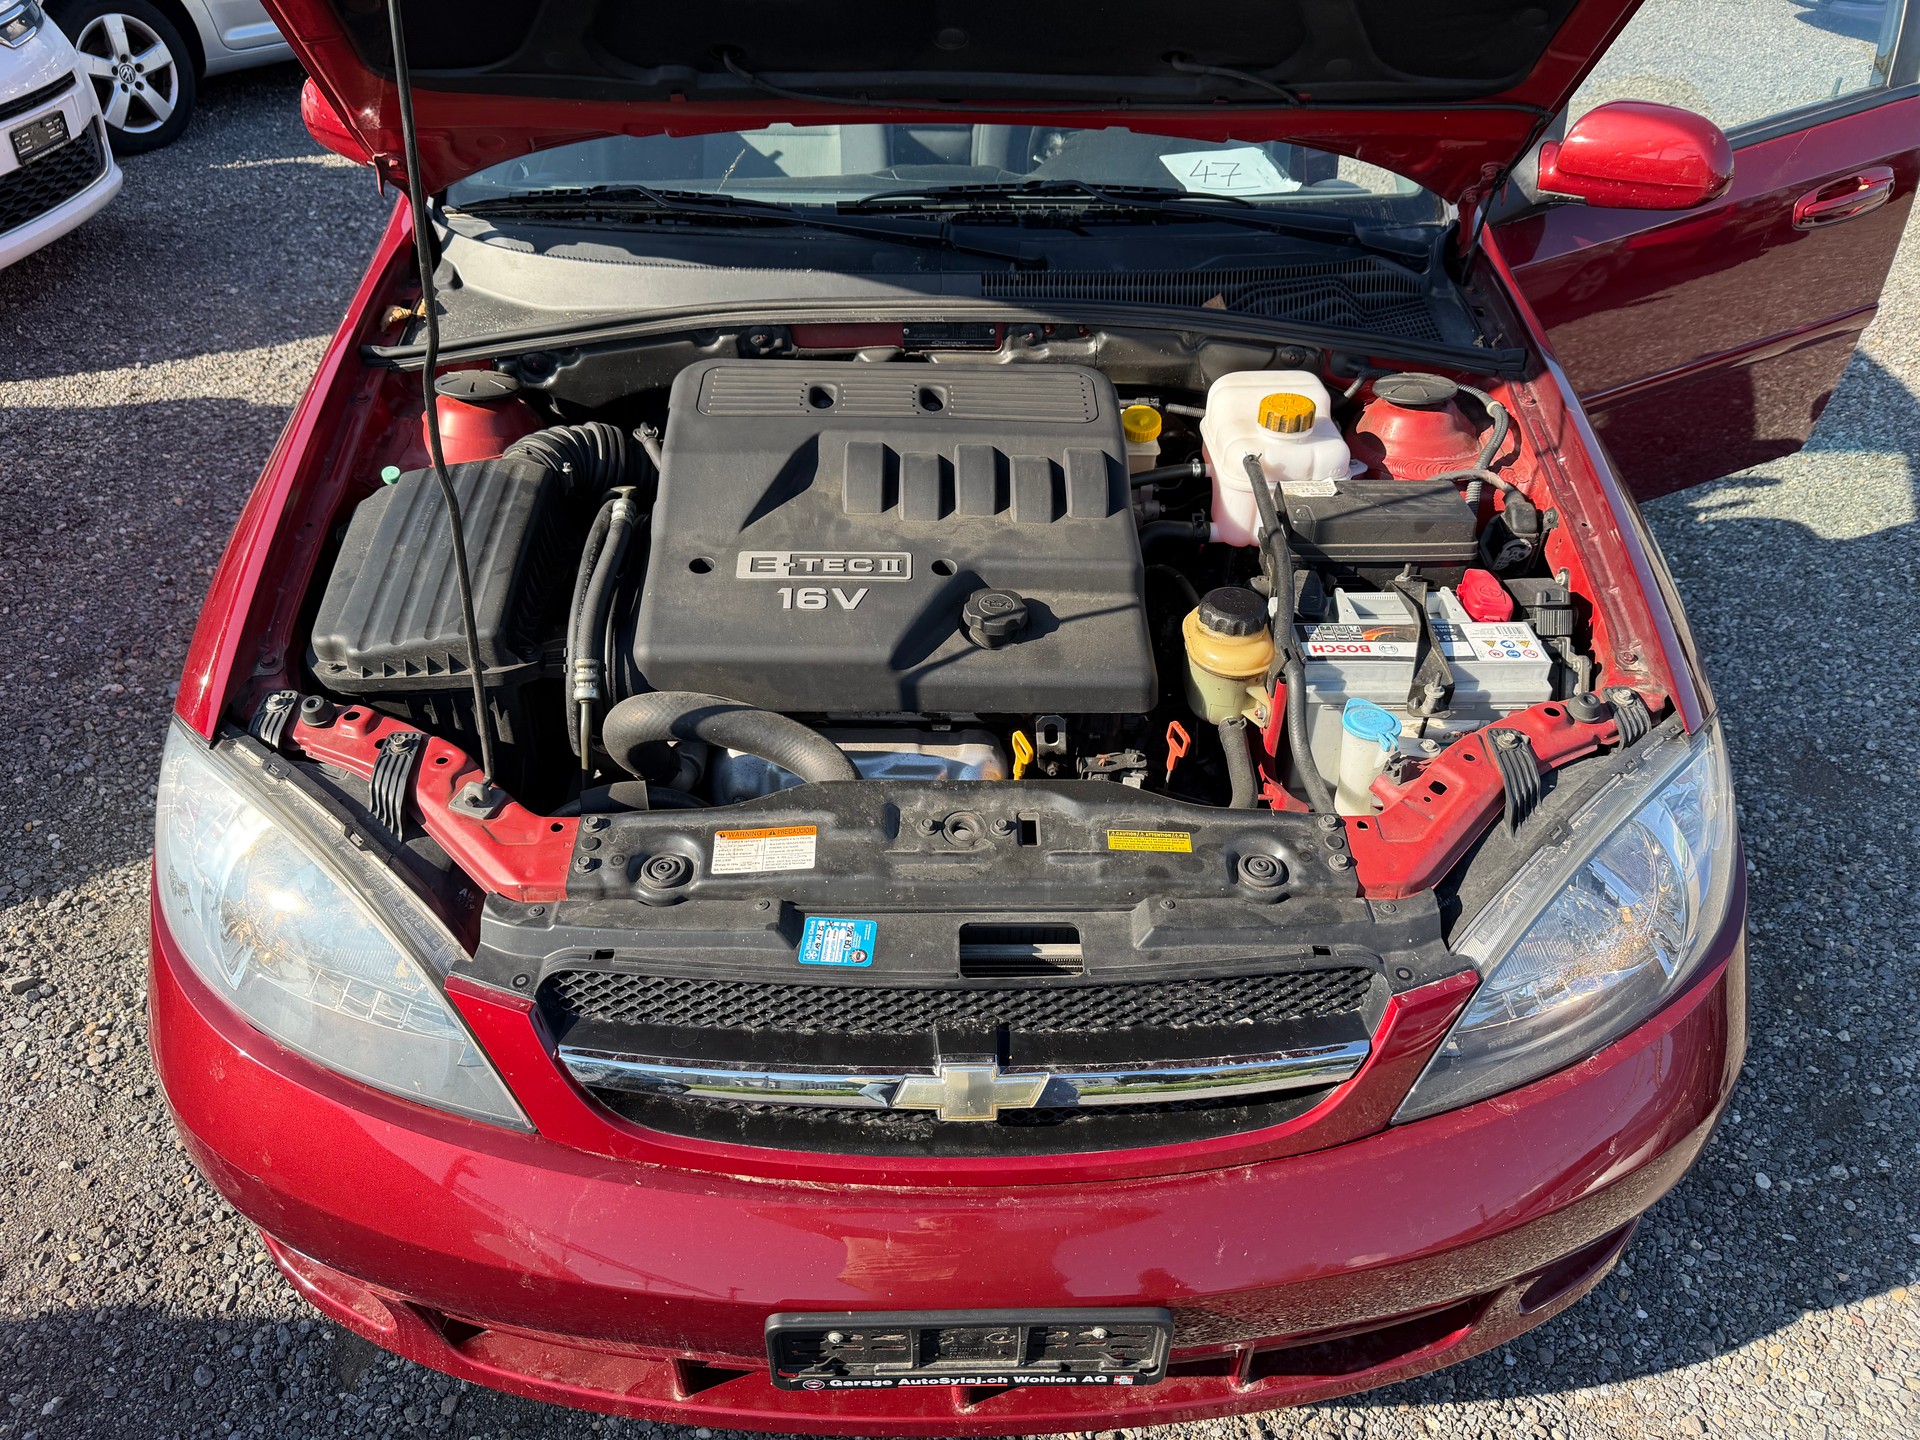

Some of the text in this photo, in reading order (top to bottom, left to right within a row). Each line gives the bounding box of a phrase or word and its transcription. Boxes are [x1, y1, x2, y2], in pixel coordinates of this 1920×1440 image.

[1189, 159, 1242, 187] 47
[777, 587, 870, 611] 16V
[1312, 644, 1372, 654] BOSCH
[728, 830, 762, 838] WARNING
[829, 1379, 893, 1387] Garage
[898, 1376, 1008, 1386] AutoSylaj.ch
[1013, 1375, 1077, 1383] Wohlen
[1082, 1375, 1108, 1383] AG
